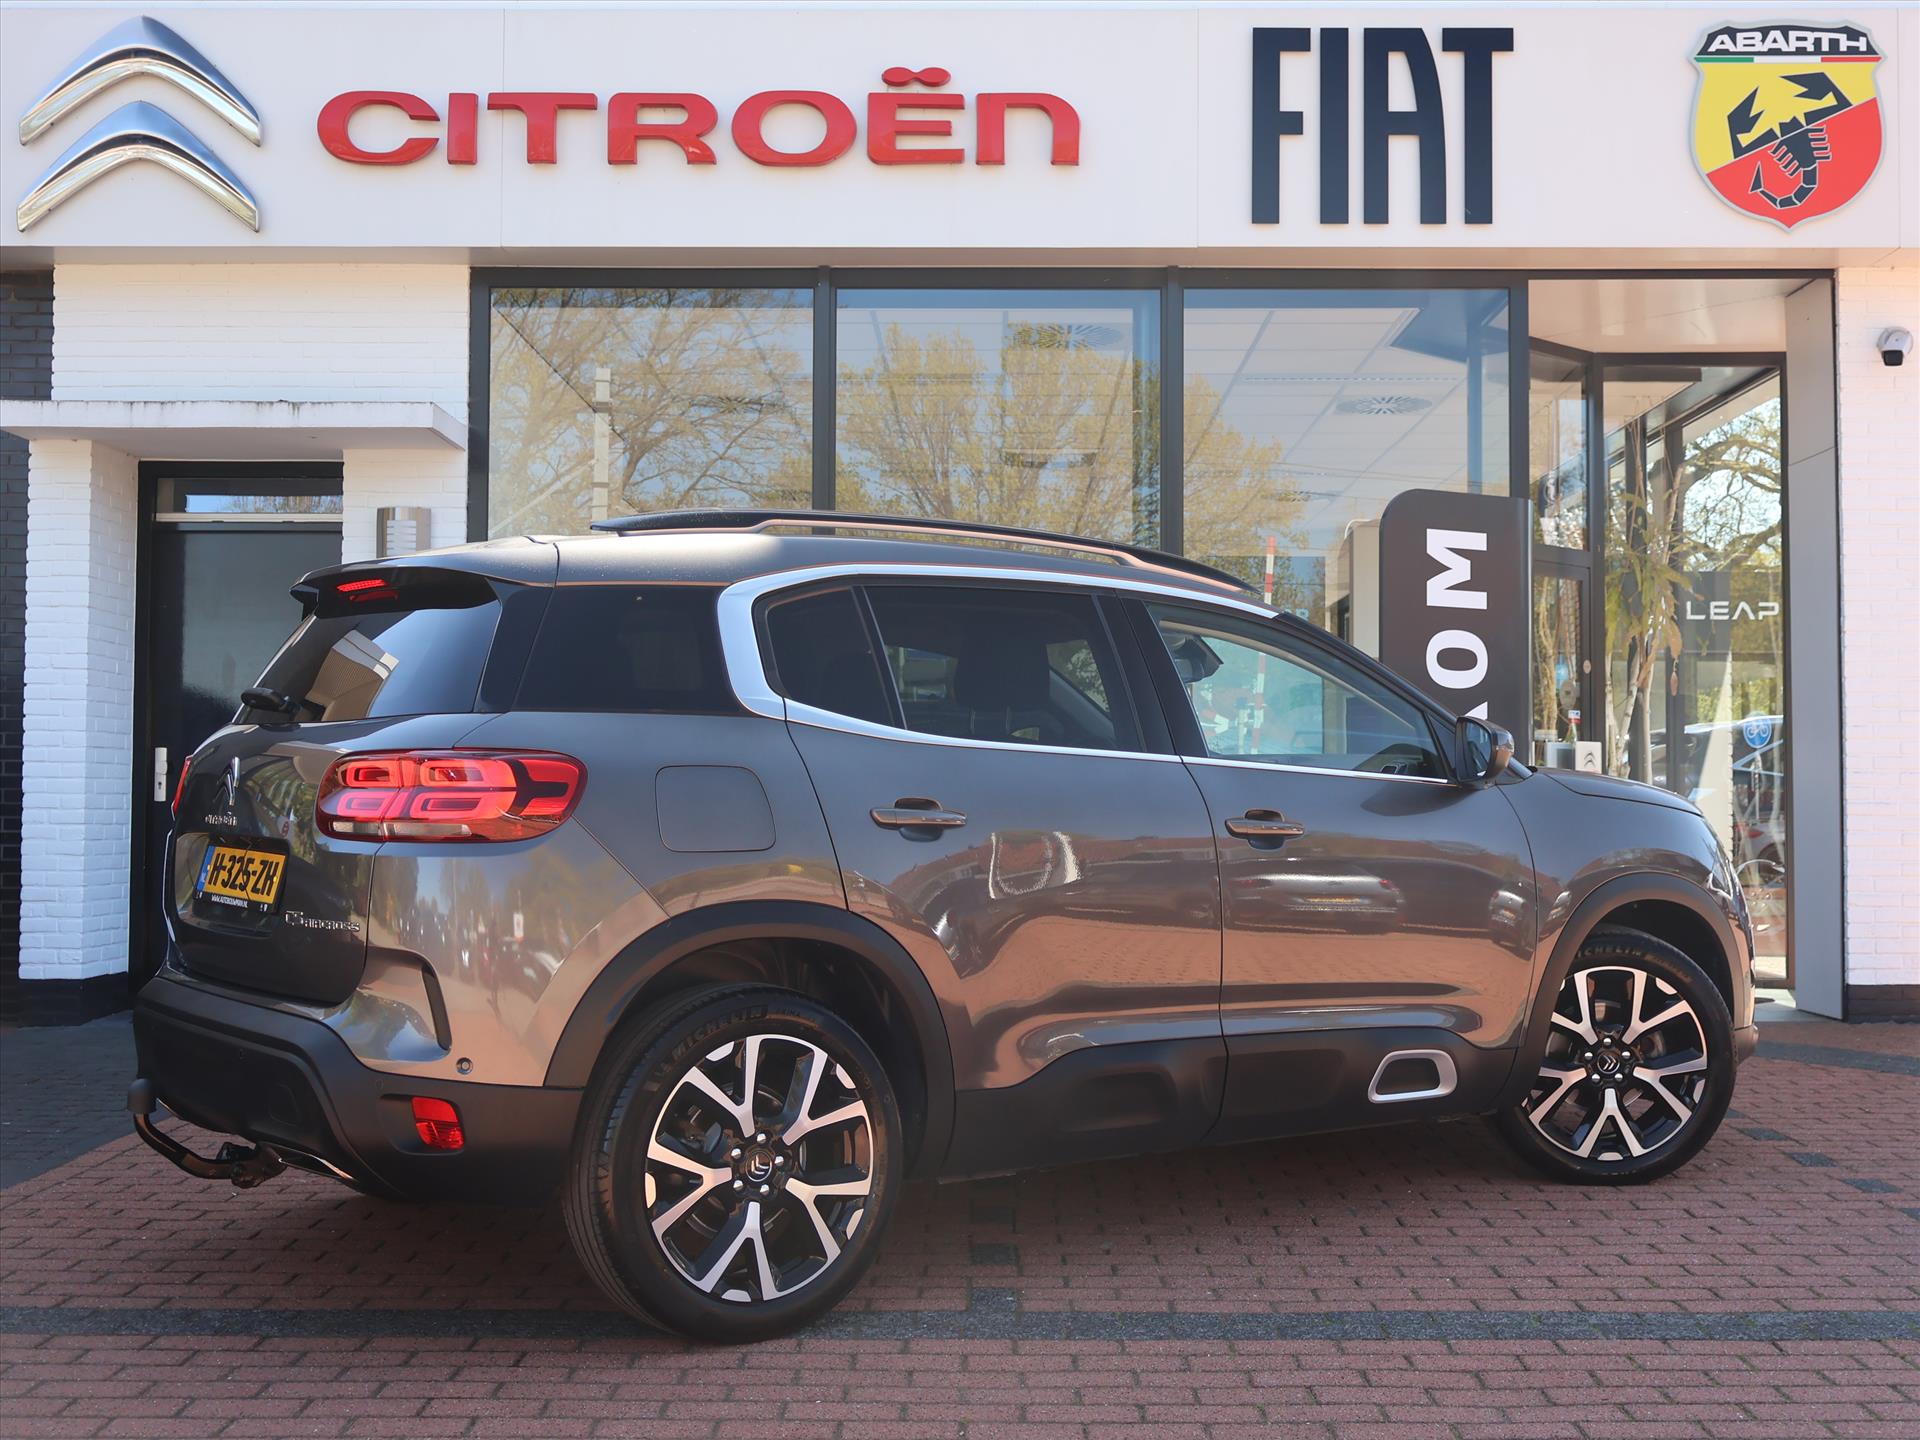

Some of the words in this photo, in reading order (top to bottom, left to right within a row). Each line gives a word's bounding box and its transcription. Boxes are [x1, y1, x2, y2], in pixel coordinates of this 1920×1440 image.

[1707, 30, 1867, 52] ABARTH
[317, 66, 1080, 167] CITROËN
[1252, 28, 1514, 224] FIAT
[1426, 528, 1488, 720] OM
[1686, 601, 1779, 620] LEAP
[208, 853, 279, 896] H-325-ZH
[1577, 945, 1642, 958] ICHELIN
